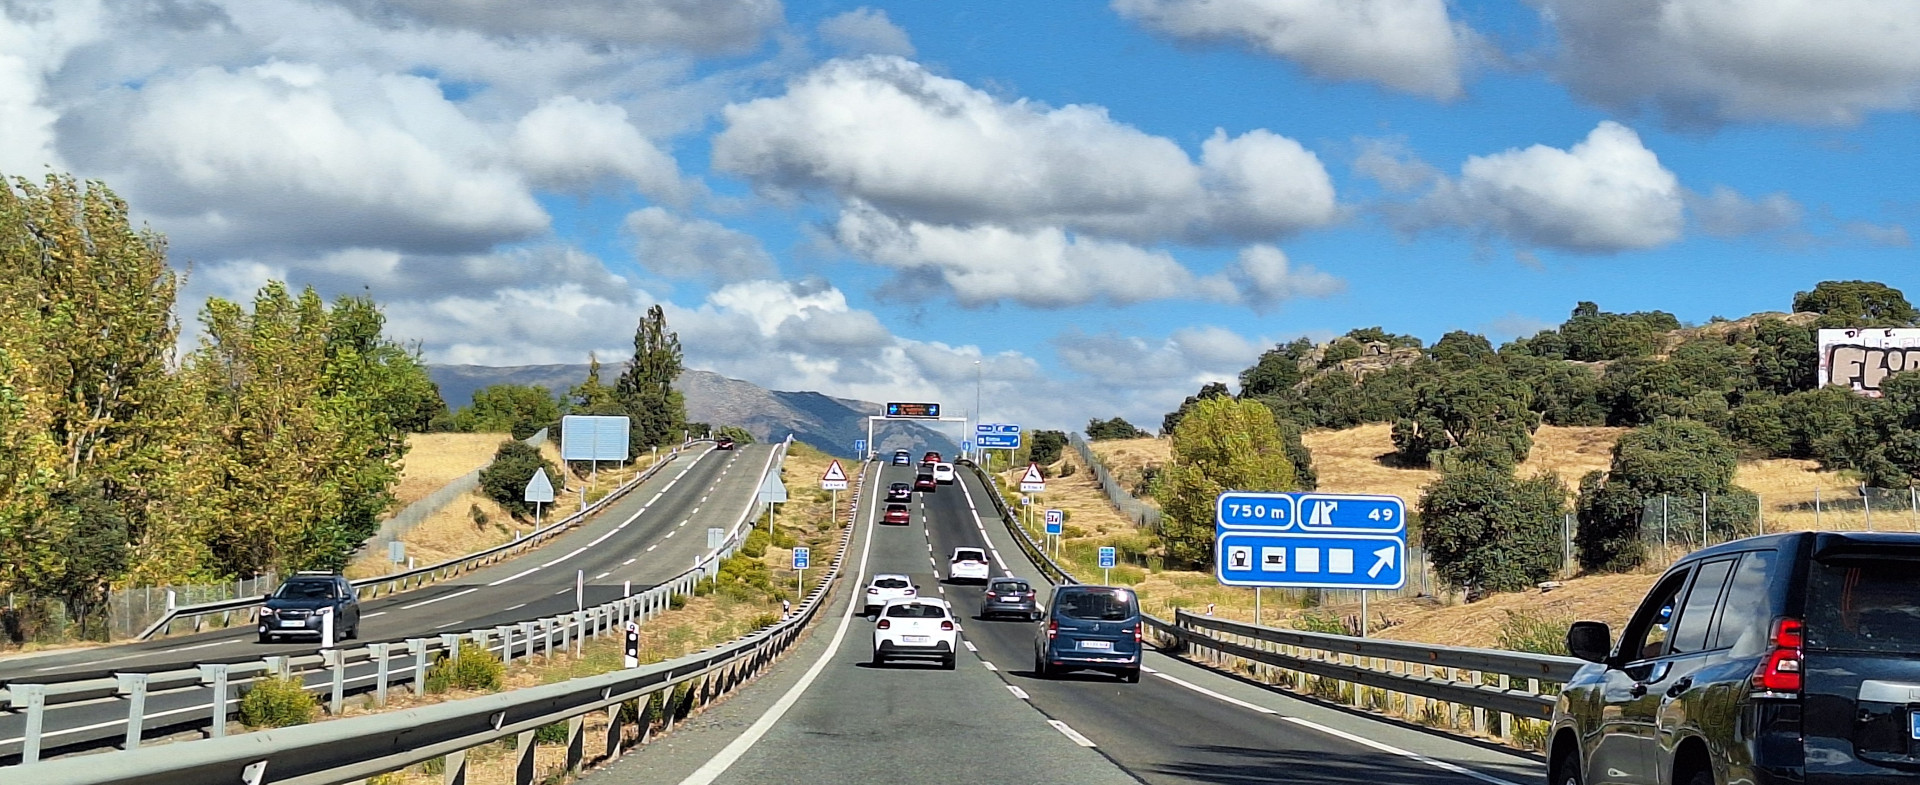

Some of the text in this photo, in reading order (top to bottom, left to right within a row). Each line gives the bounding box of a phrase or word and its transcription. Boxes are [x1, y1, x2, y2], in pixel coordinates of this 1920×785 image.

[1228, 504, 1285, 519] 750 m
[1368, 508, 1393, 521] 49
